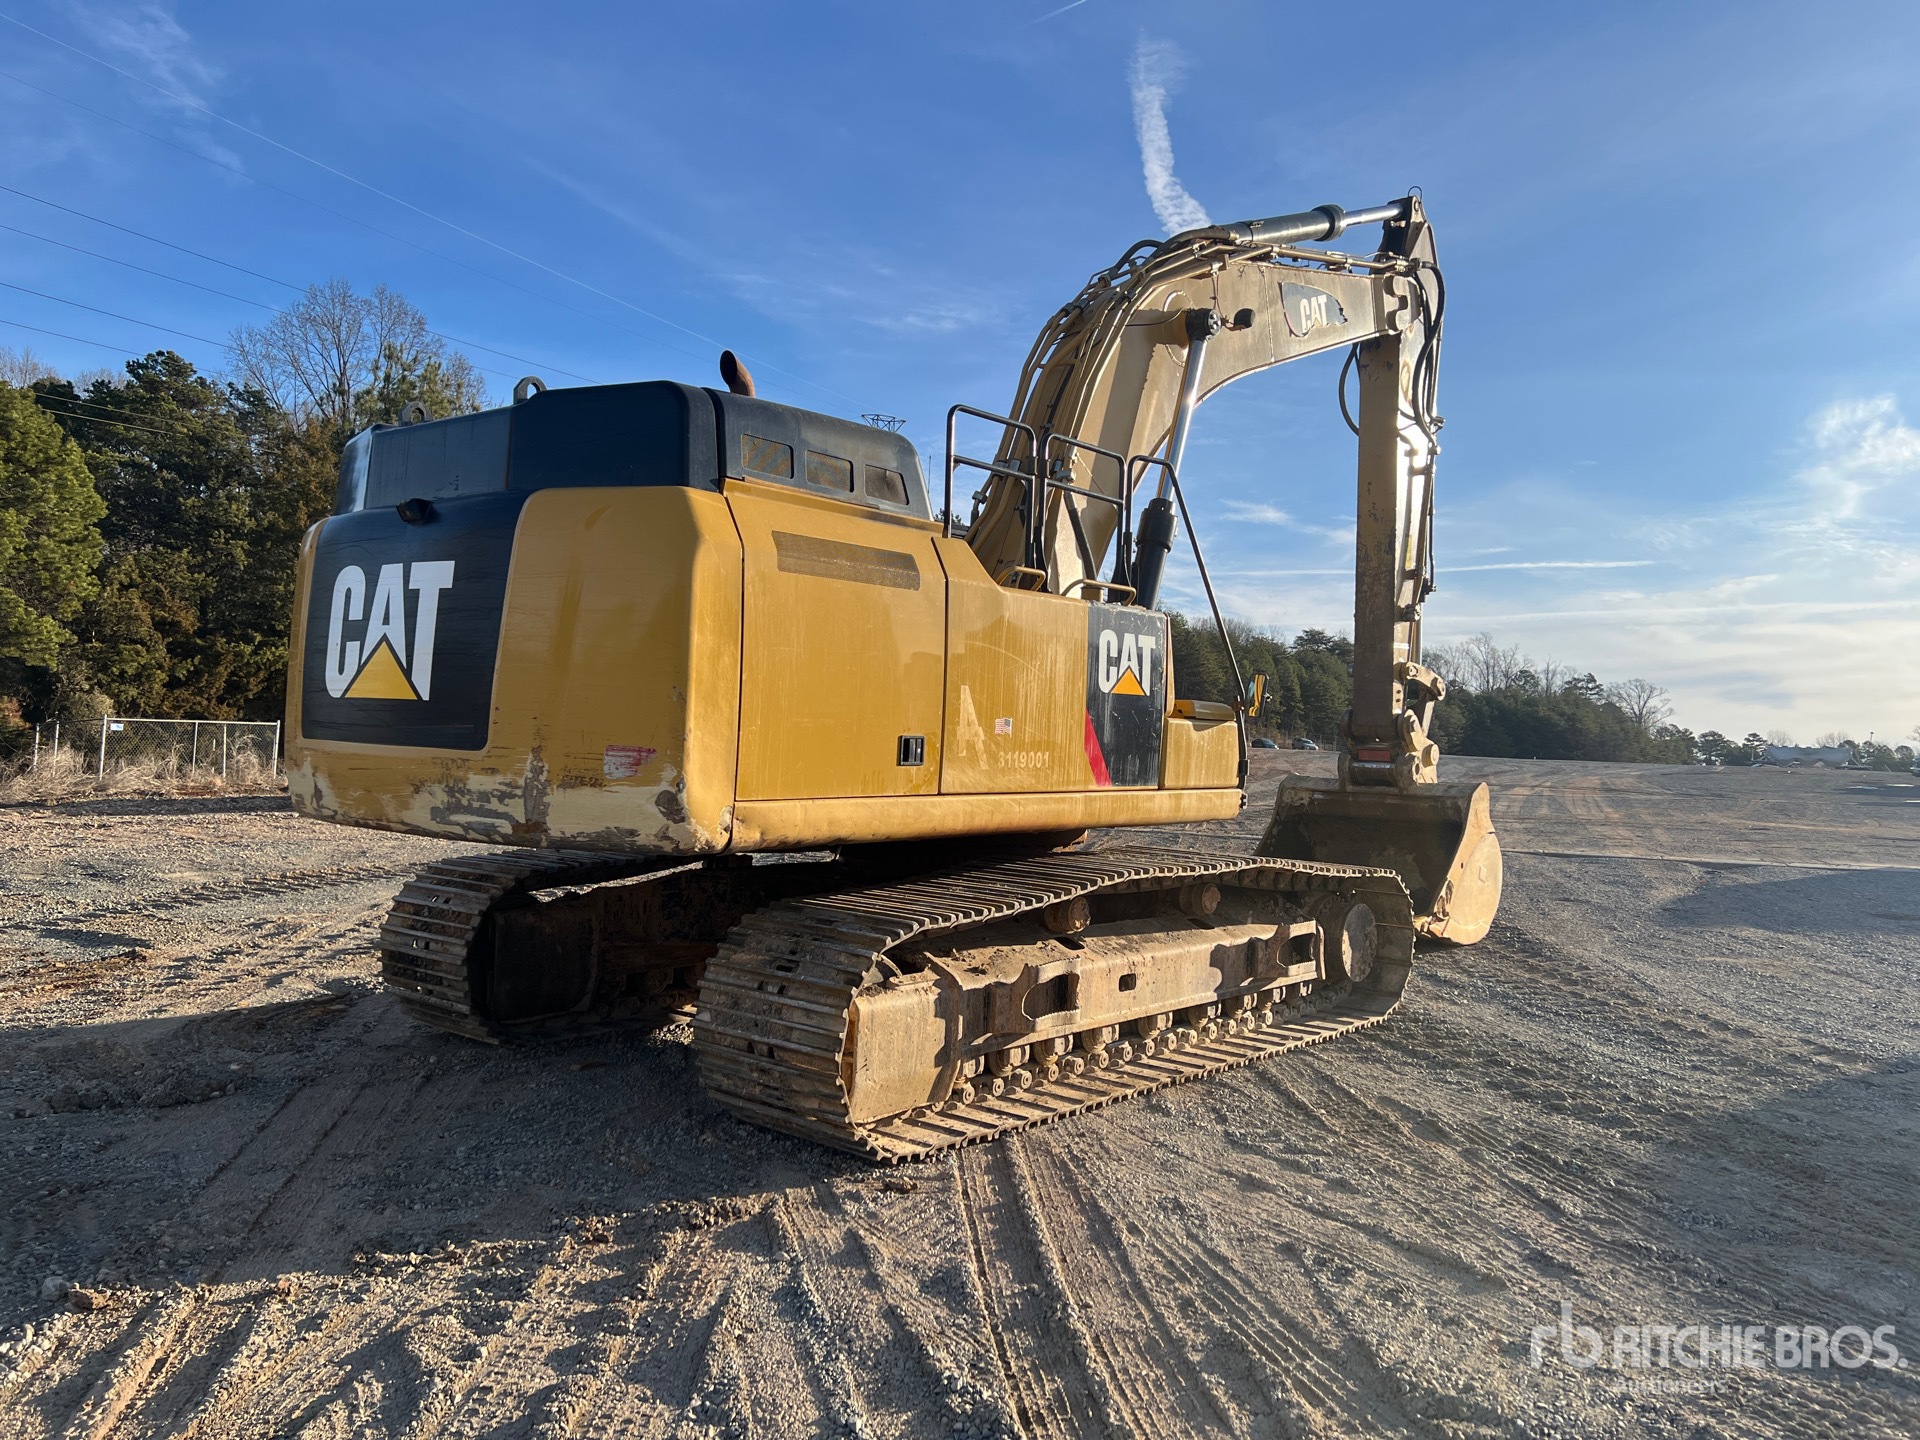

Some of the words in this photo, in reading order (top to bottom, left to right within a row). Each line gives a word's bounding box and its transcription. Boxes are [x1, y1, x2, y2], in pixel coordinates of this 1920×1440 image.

[1301, 295, 1327, 332] CAT
[325, 561, 454, 701] CAT
[1099, 629, 1156, 696] CAT
[998, 751, 1049, 768] 3119001
